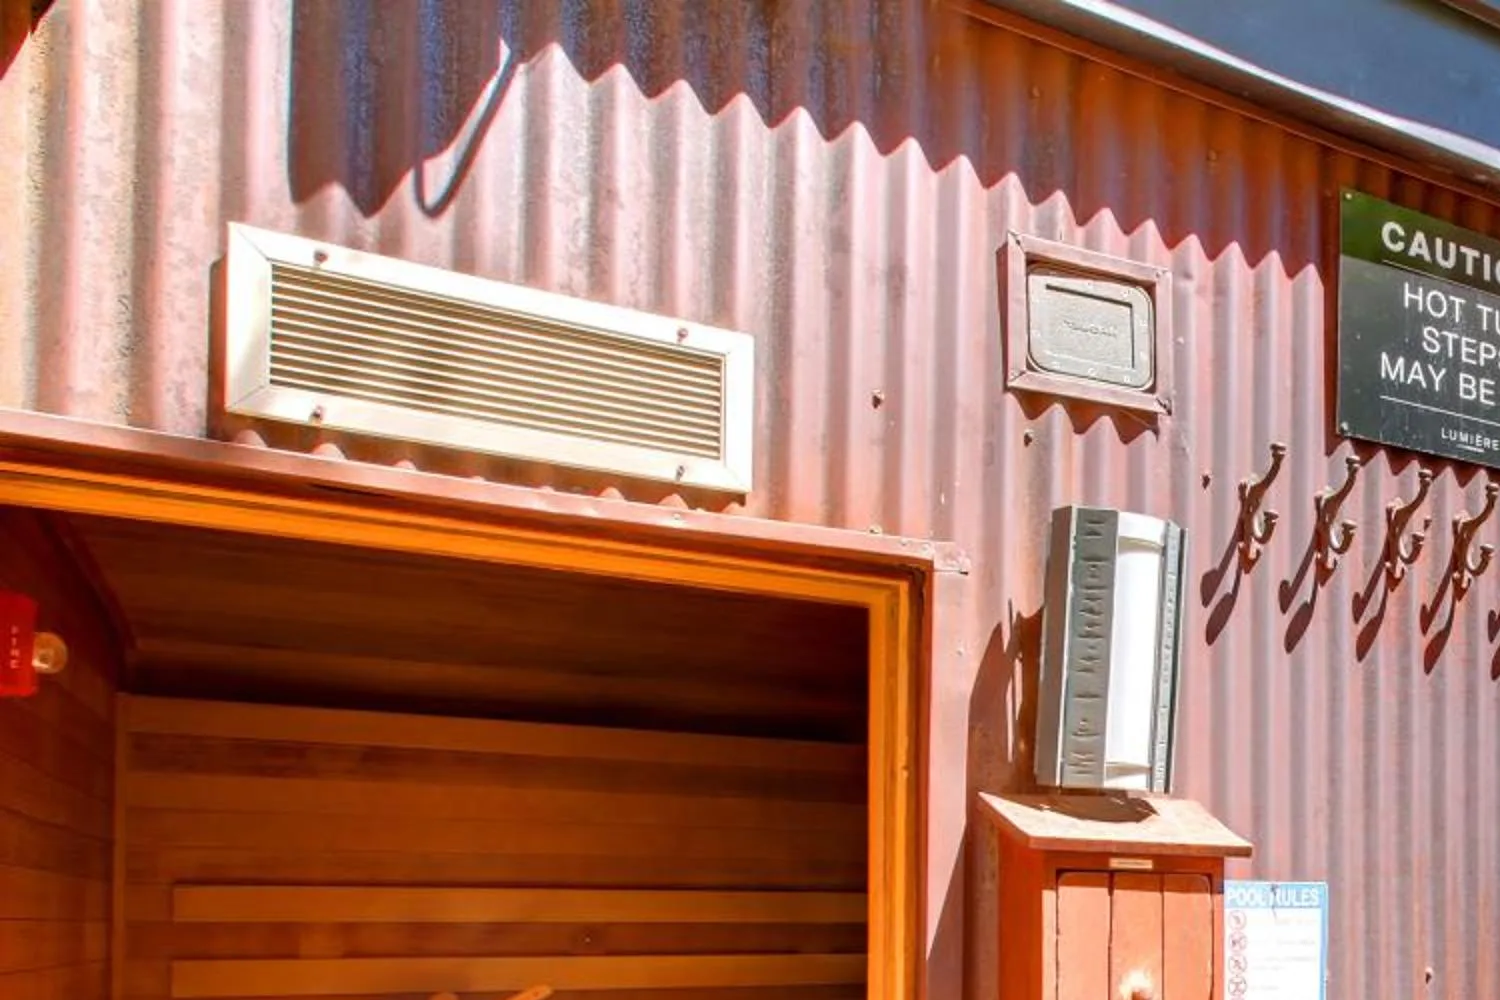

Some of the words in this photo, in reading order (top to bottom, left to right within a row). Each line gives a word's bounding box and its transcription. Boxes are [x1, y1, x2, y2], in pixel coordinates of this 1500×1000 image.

[1403, 282, 1466, 324] HOT
[1381, 351, 1447, 392] MAY
[1458, 373, 1496, 406] BE
[1226, 887, 1268, 907] POOL
[1269, 887, 1320, 907] RULES
